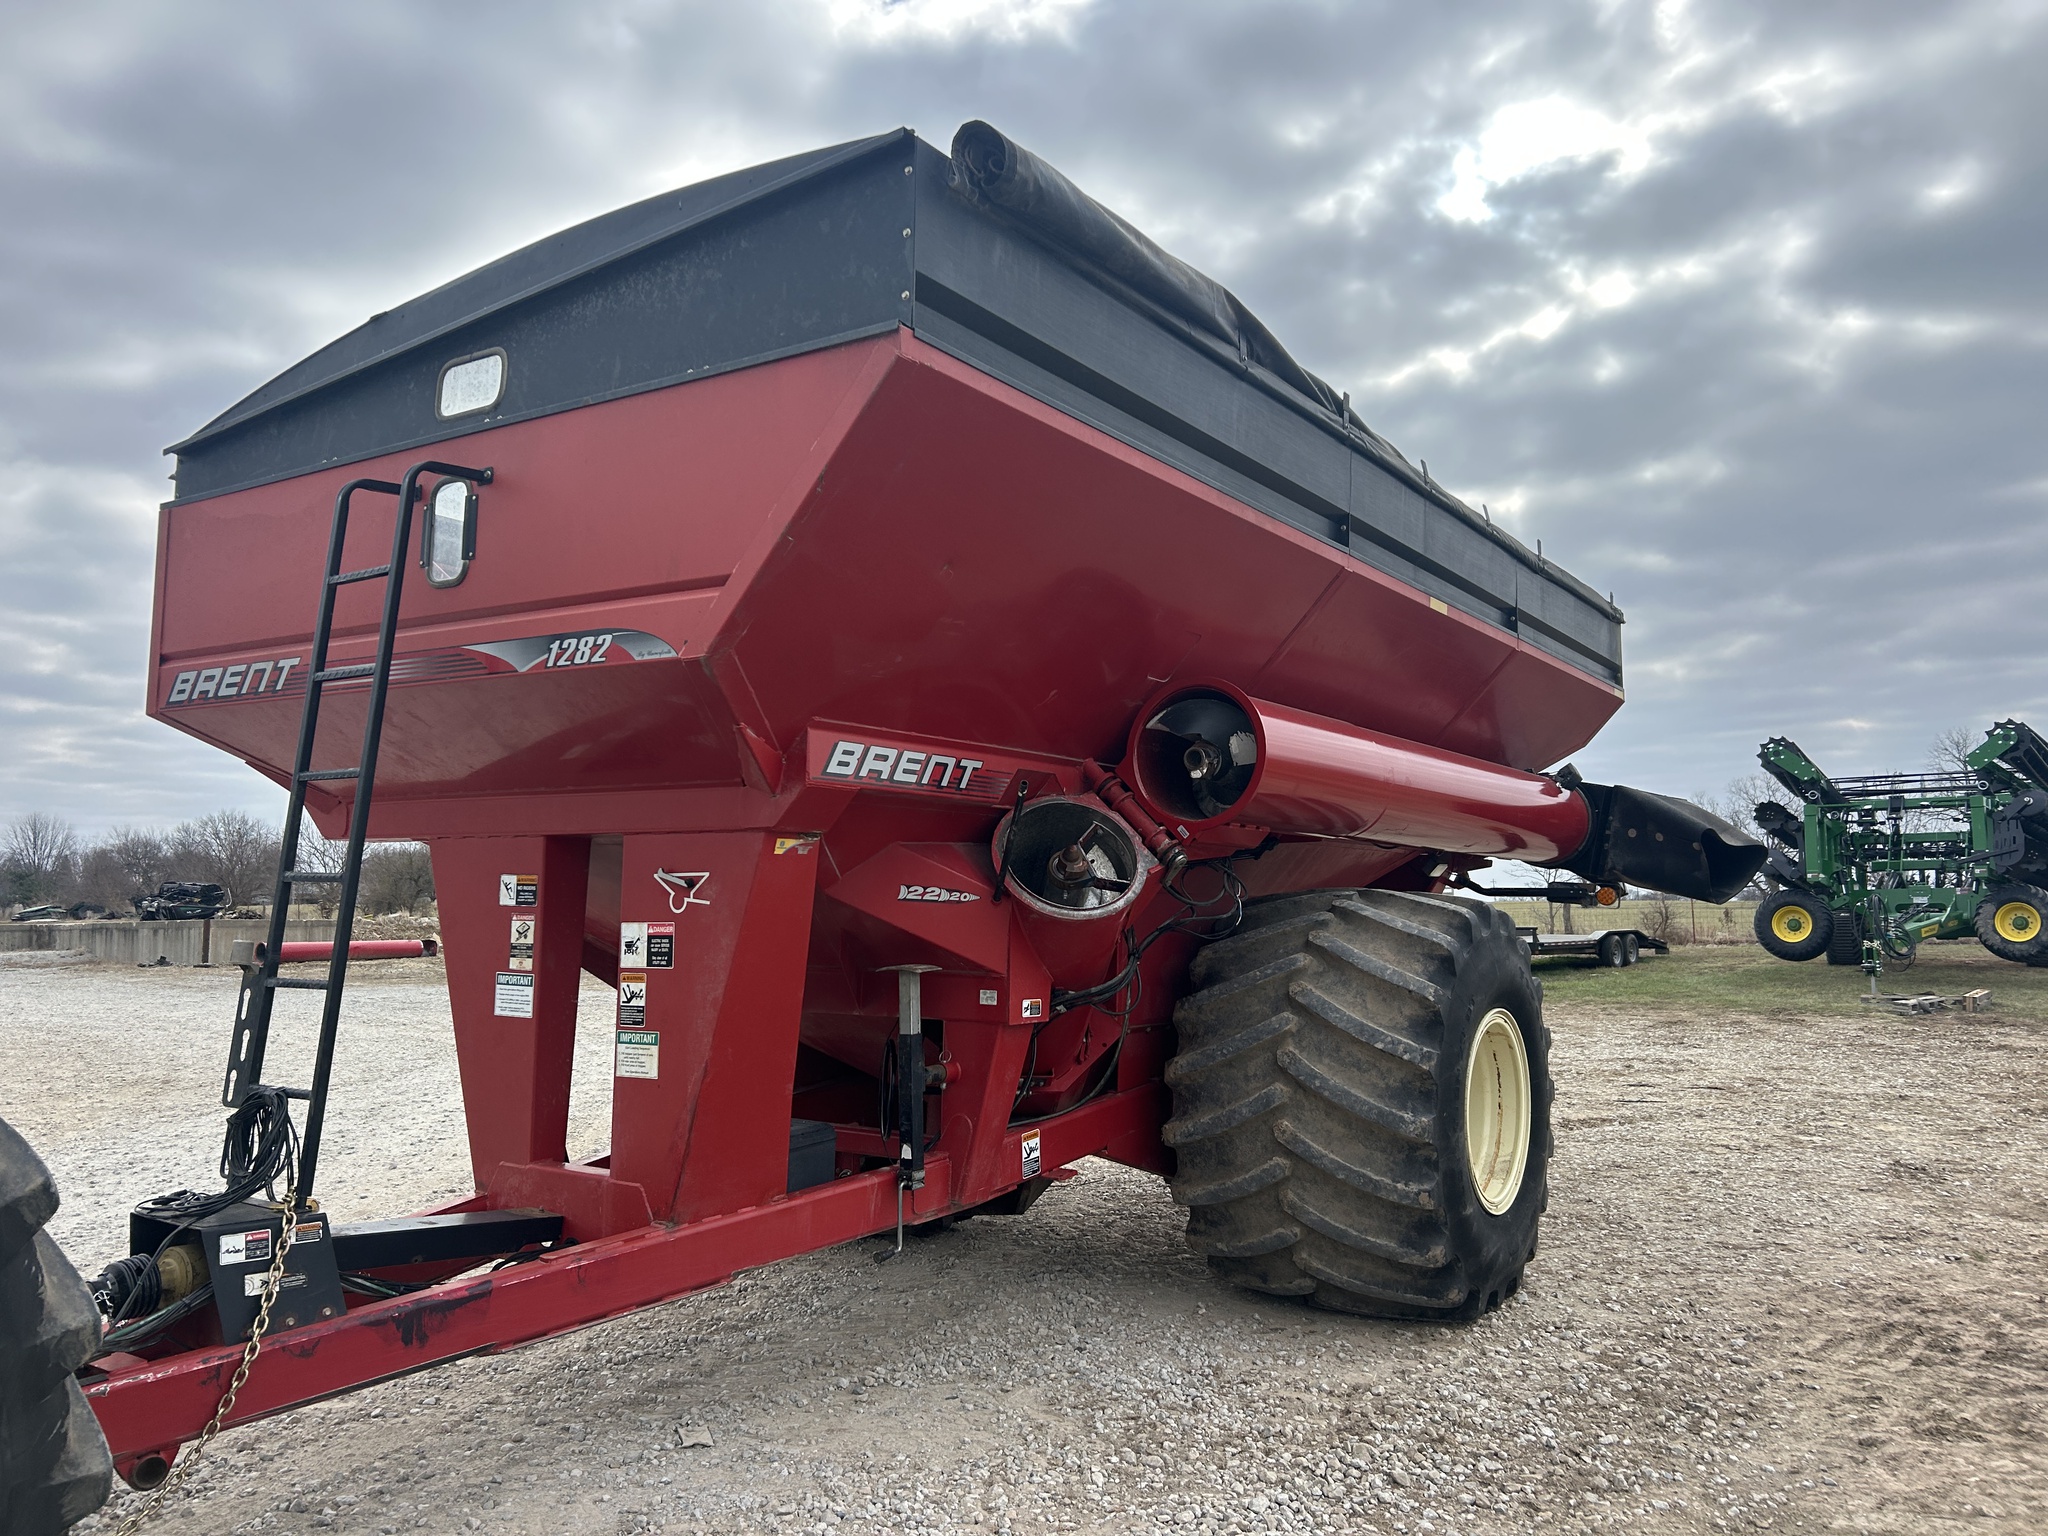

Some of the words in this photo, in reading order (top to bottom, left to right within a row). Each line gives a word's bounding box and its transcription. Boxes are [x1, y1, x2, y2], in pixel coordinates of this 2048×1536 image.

[546, 633, 613, 668] 1282
[166, 657, 302, 703] BRENT
[823, 740, 984, 791] BRENT
[497, 974, 532, 986] IMPORTANT
[619, 1032, 656, 1044] IMPORTANT
